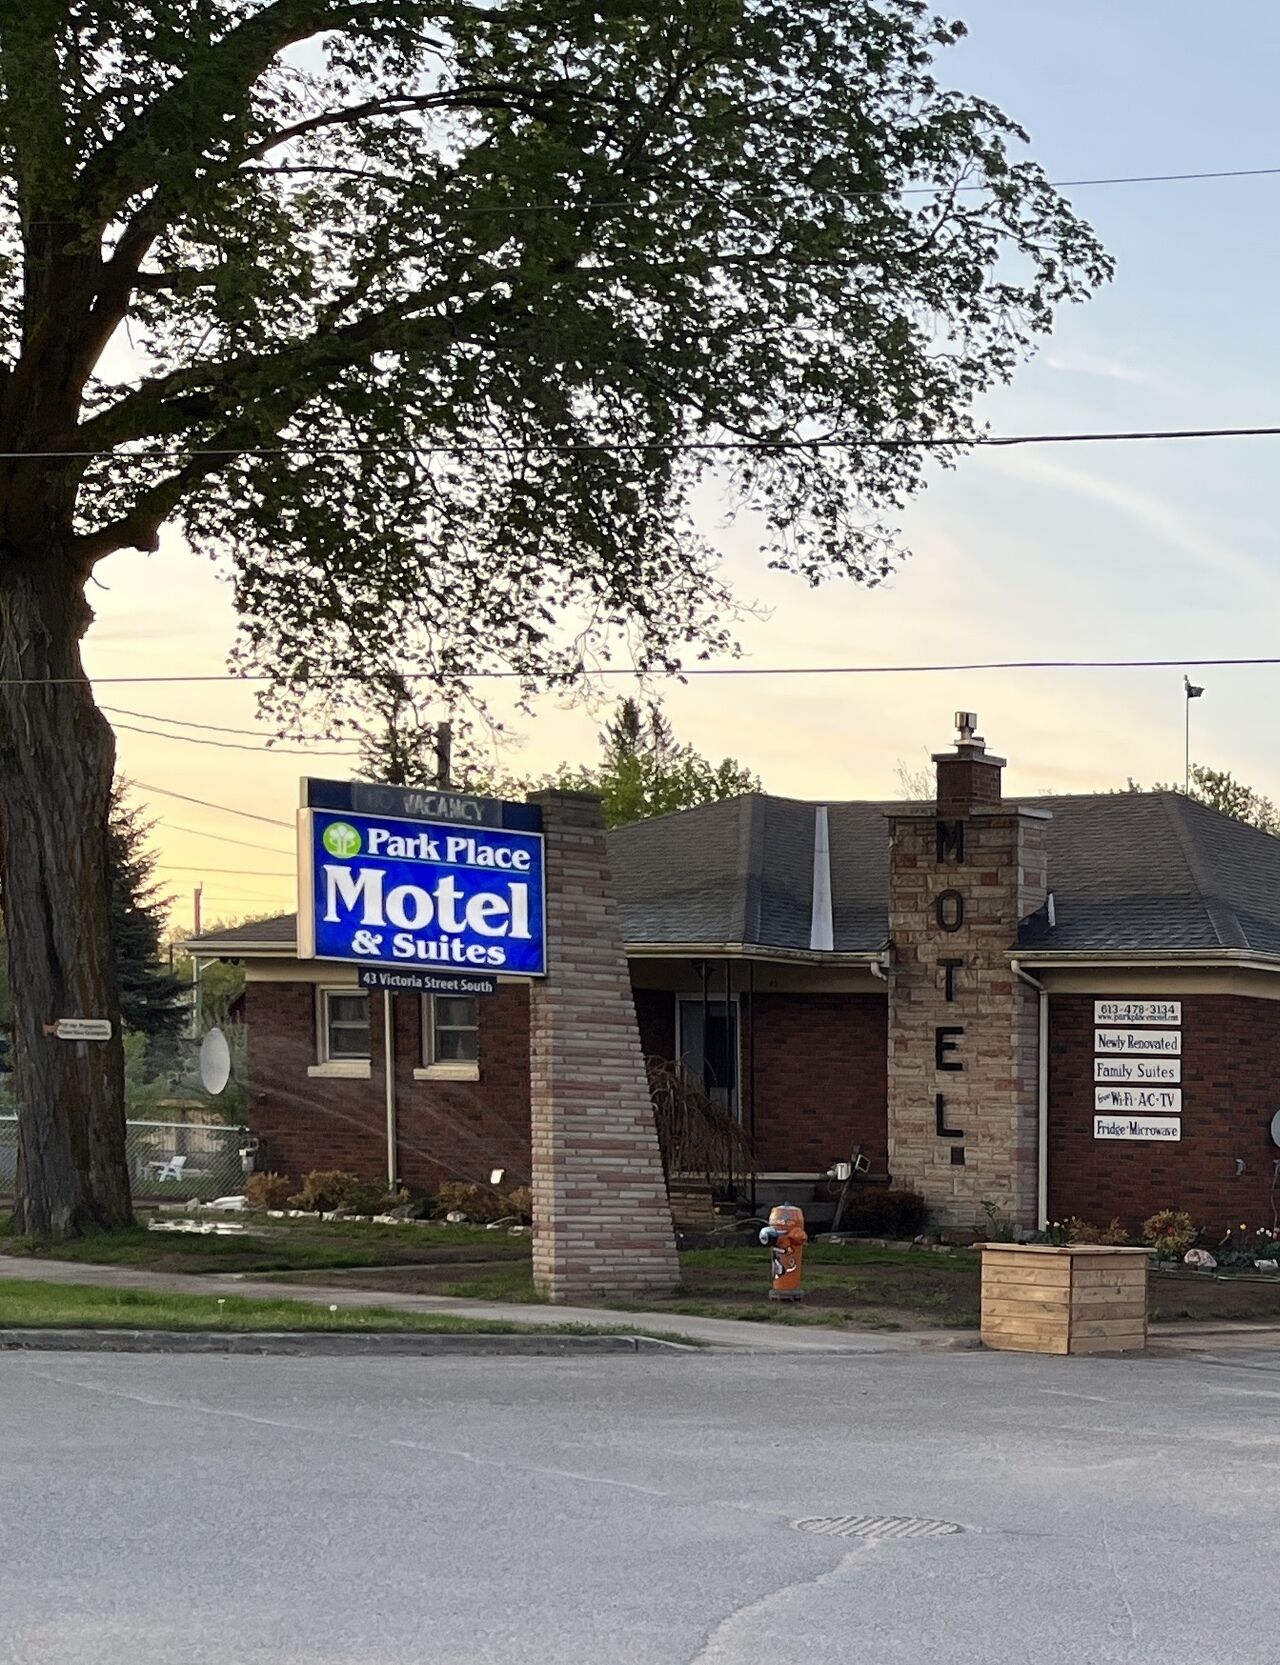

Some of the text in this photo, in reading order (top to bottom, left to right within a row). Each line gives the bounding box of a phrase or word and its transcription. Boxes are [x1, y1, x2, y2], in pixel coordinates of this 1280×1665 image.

[403, 793, 486, 821] VACANCY
[367, 828, 532, 870] Park Place
[323, 864, 532, 939] Motel
[351, 929, 506, 965] & Suites
[363, 973, 493, 993] 43 Victoria Street South
[1100, 1004, 1175, 1014] 613-478-3134
[1098, 1034, 1178, 1051] Newly Renovated
[1097, 1063, 1174, 1080] Family Suites
[1160, 1093, 1174, 1107] TV
